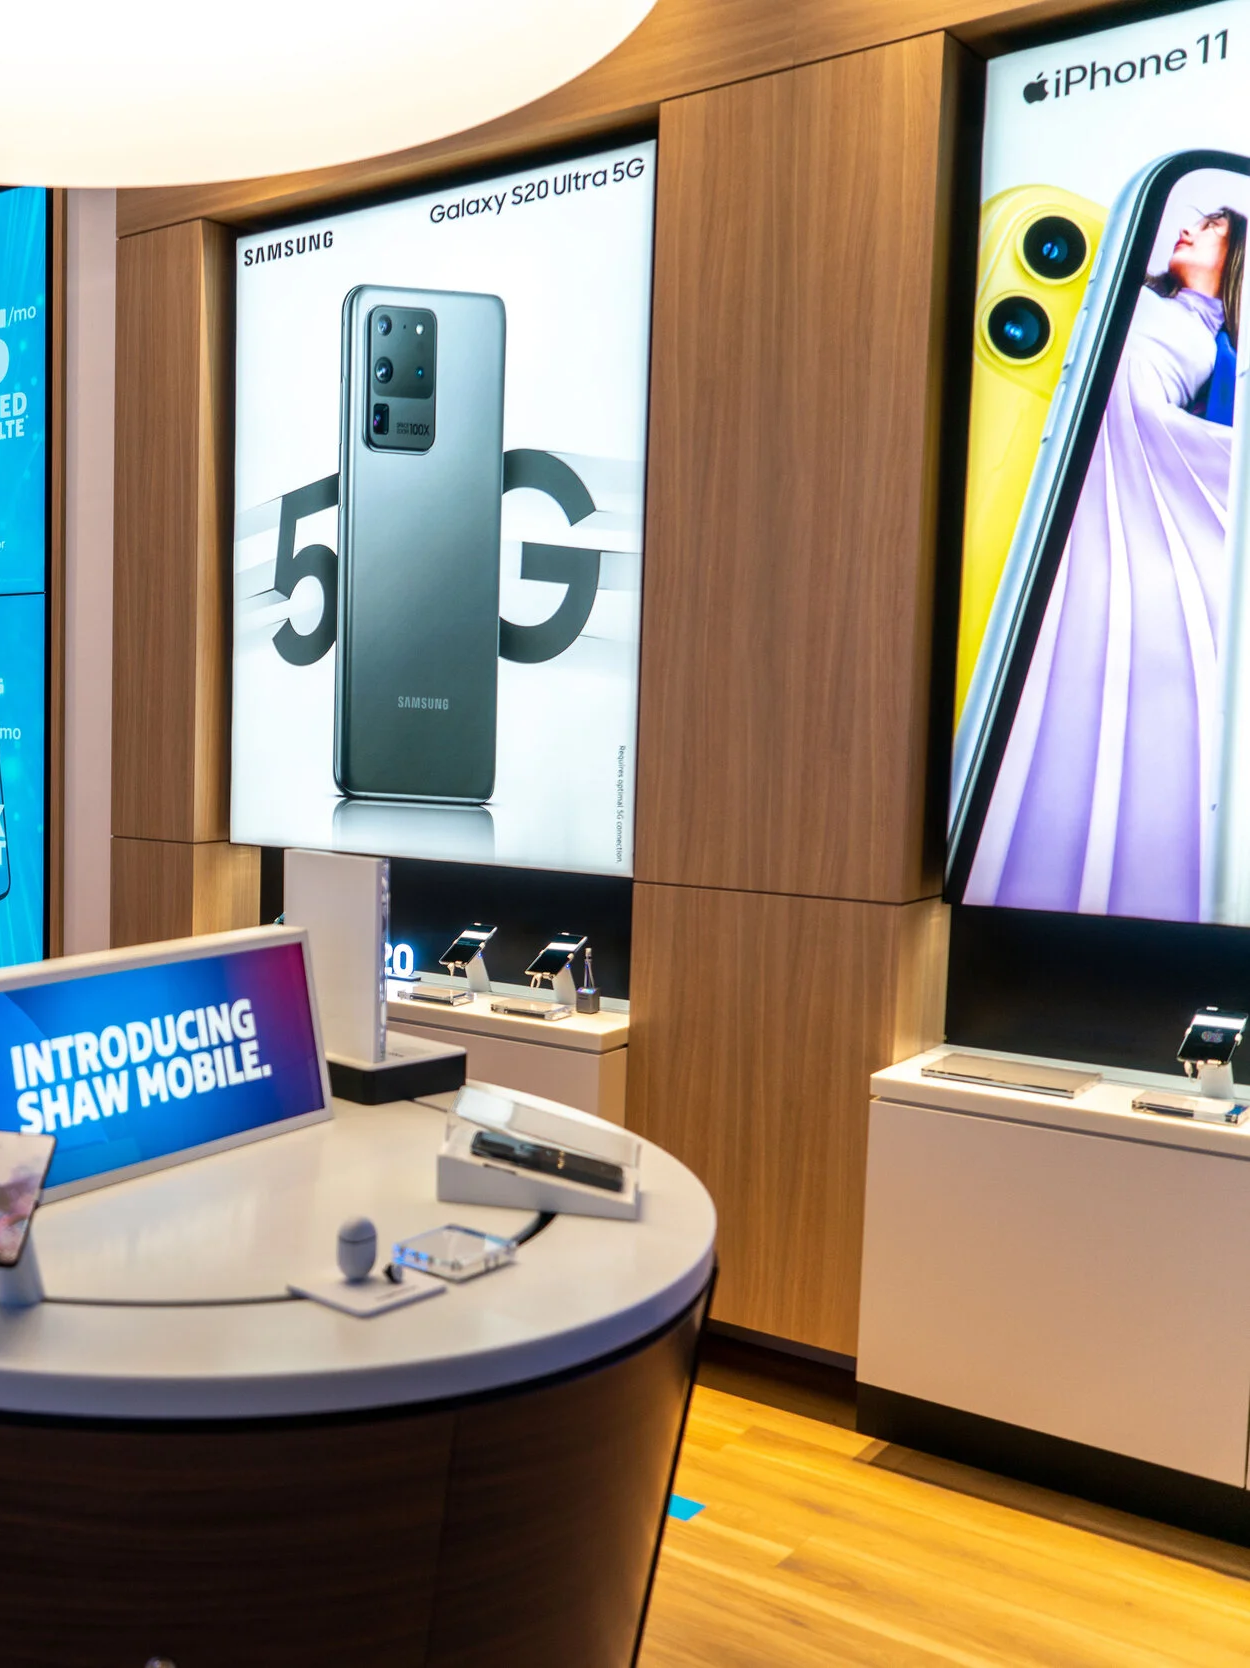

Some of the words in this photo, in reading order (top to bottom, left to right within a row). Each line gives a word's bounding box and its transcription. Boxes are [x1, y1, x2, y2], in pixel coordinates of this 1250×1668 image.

[1054, 47, 1188, 98] iPhone
[1196, 28, 1229, 64] 11
[430, 192, 507, 223] Galaxy
[511, 179, 550, 206] S20
[553, 168, 608, 196] Ultra
[612, 157, 645, 183] 5G
[243, 230, 334, 267] SAMSUNG
[397, 695, 449, 711] SAMSUNG
[616, 745, 626, 778] Requires
[616, 779, 625, 808] optimal
[10, 998, 257, 1090] INTRODUCING
[16, 1070, 129, 1135] SHAW
[136, 1040, 272, 1108] MOBILE.
